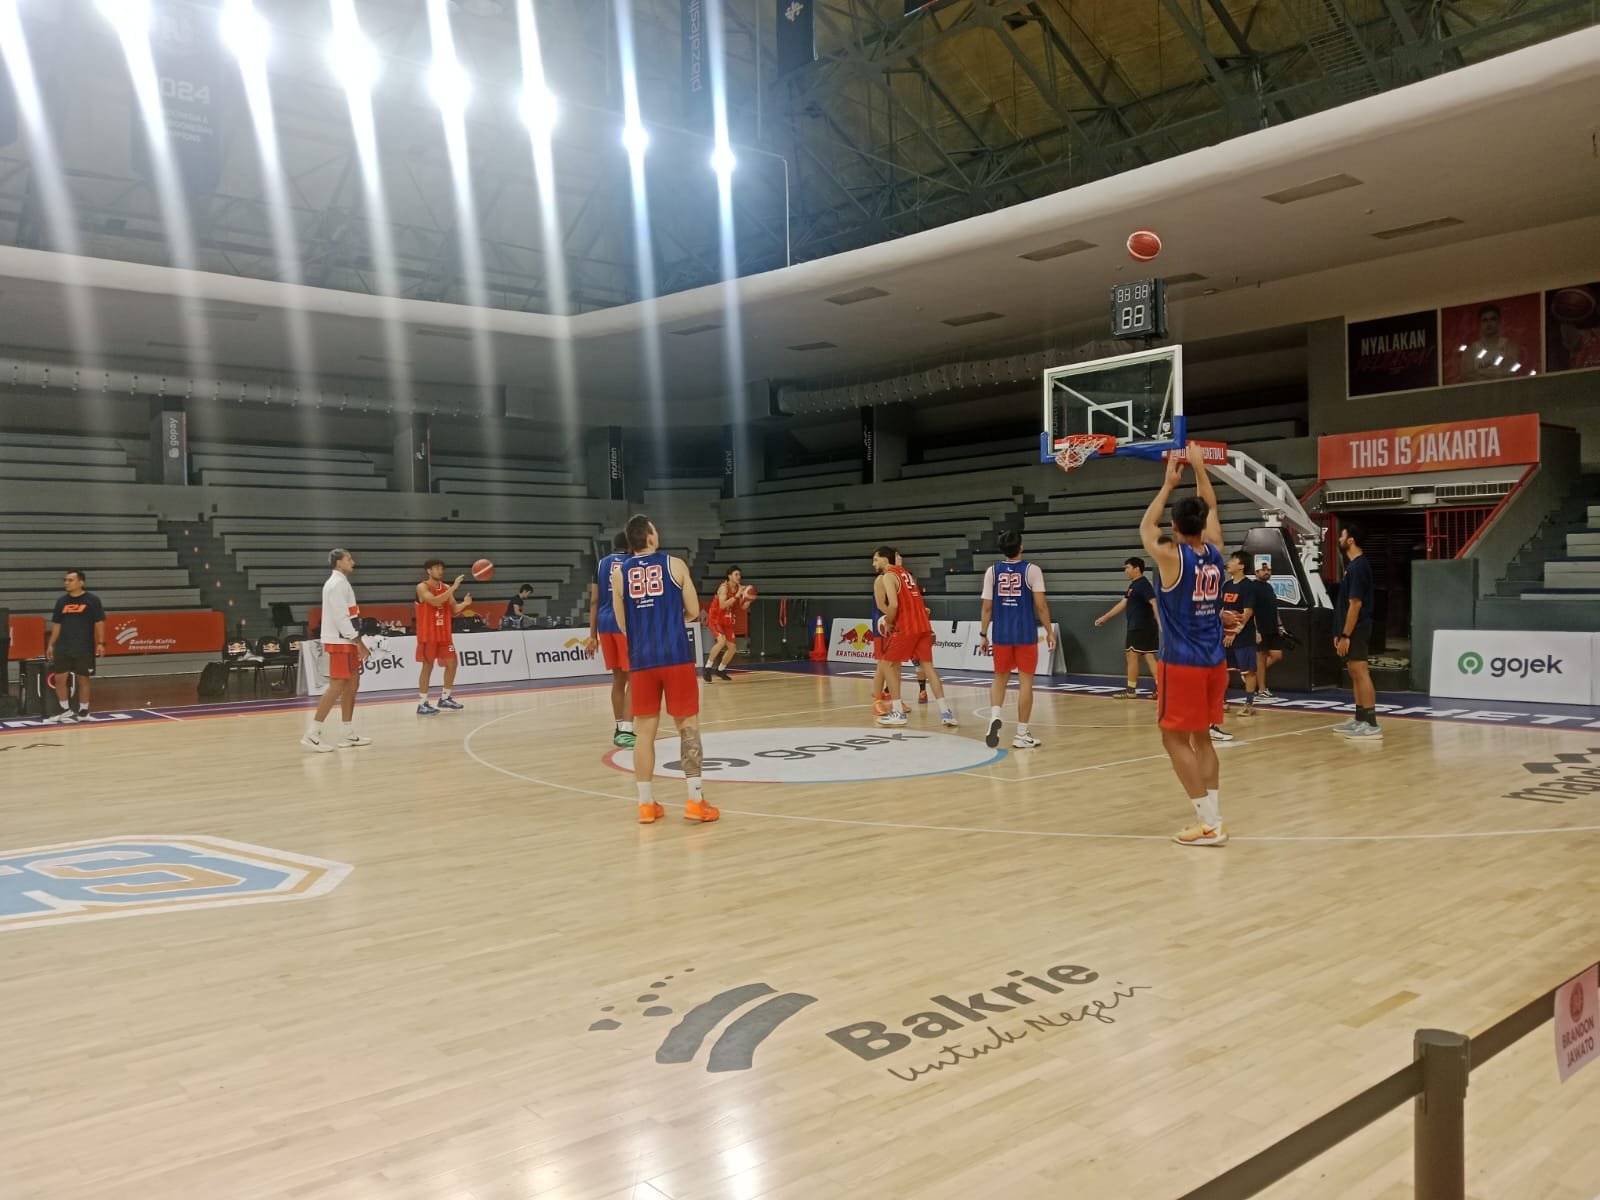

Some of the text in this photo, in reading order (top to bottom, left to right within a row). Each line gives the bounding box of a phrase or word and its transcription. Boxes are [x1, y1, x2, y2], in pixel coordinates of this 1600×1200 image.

[159, 77, 211, 104] 024
[1361, 328, 1426, 357] NYALAKAN
[1349, 426, 1501, 469] THIS IS JAKARTA
[627, 564, 664, 599] 88
[997, 572, 1022, 597] 22
[1192, 563, 1221, 602] 10
[459, 649, 513, 667] IBLTV
[1490, 654, 1563, 679] gojek
[1224, 696, 1600, 729] BASKET
[754, 733, 931, 761] gojek
[825, 965, 1099, 1061] Bakrie
[1562, 1015, 1594, 1049] BRANDON
[887, 1026, 1027, 1082] Untuk
[1567, 1036, 1594, 1068] JAWATO
